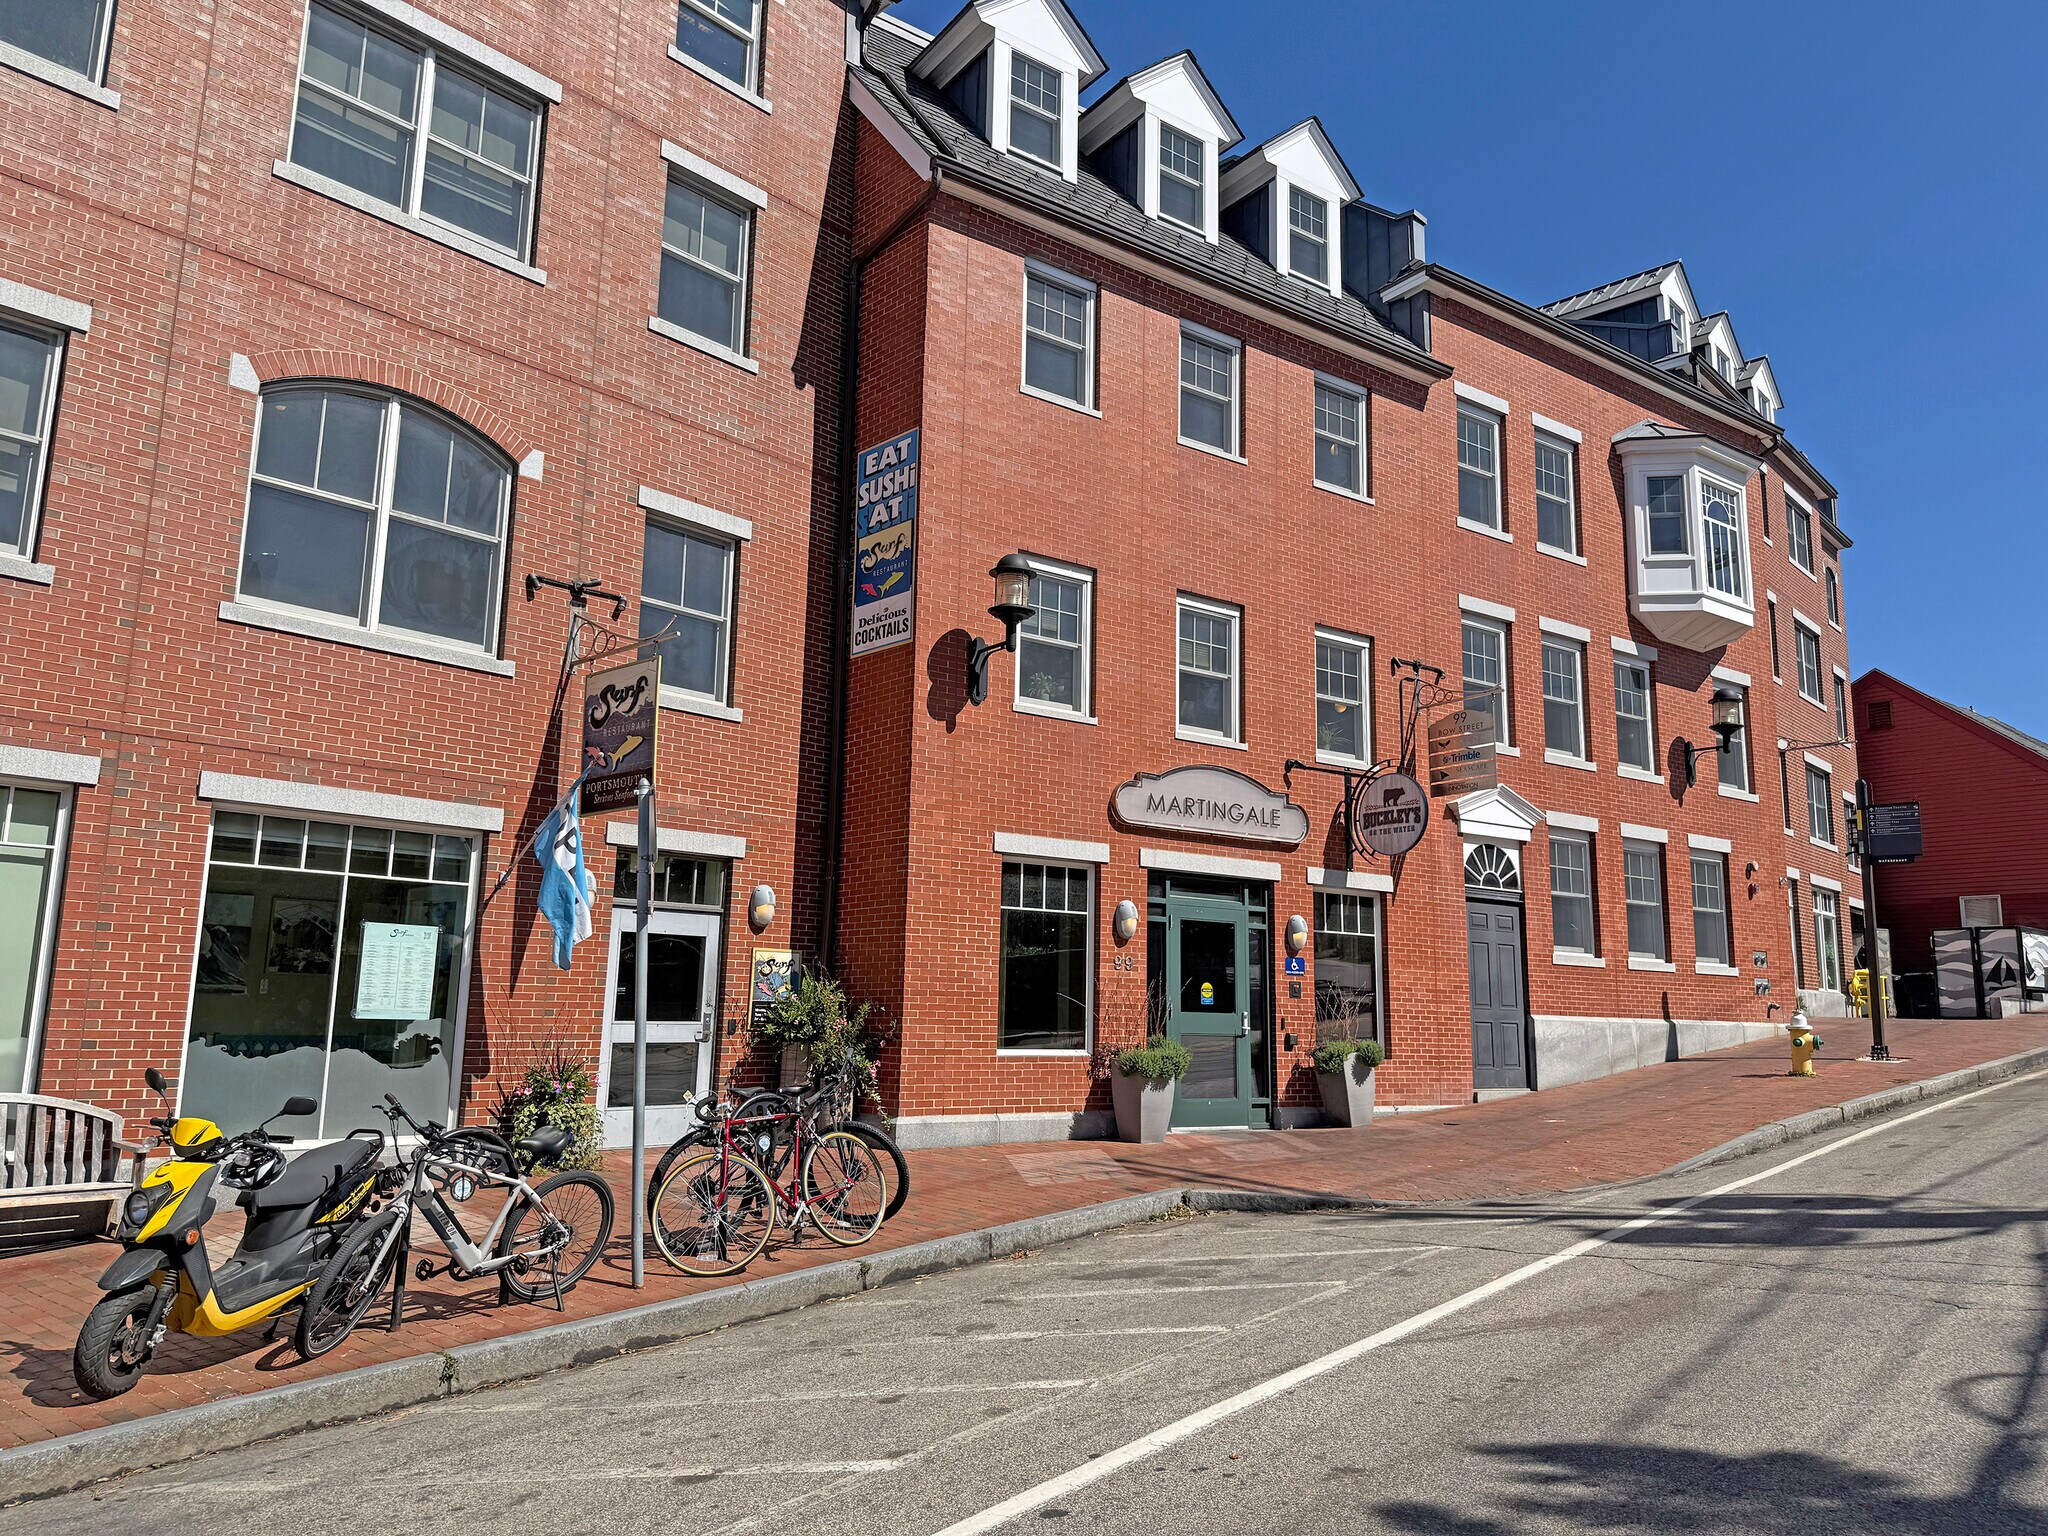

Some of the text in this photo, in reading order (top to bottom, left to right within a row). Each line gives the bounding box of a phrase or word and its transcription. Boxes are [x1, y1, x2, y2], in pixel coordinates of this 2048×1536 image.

[865, 438, 912, 476] EAT
[869, 495, 903, 528] AT
[862, 532, 905, 569] Surf
[872, 559, 908, 577] RESTAURANT
[858, 607, 907, 629] Delicious
[854, 617, 909, 647] COCKTAILS
[589, 675, 649, 727] Surf
[1453, 711, 1468, 725] 99
[603, 719, 651, 737] RESTAURANT
[1438, 721, 1484, 737] BOW STREET
[1451, 750, 1481, 763] Trimble
[1147, 792, 1281, 828] MARTINGALE
[1363, 806, 1421, 830] BUCKLEY'S
[1379, 827, 1392, 835] THE
[1393, 825, 1416, 833] WATER
[389, 928, 408, 938] Surf
[759, 958, 796, 977] Surf
[1113, 954, 1134, 971] 99
